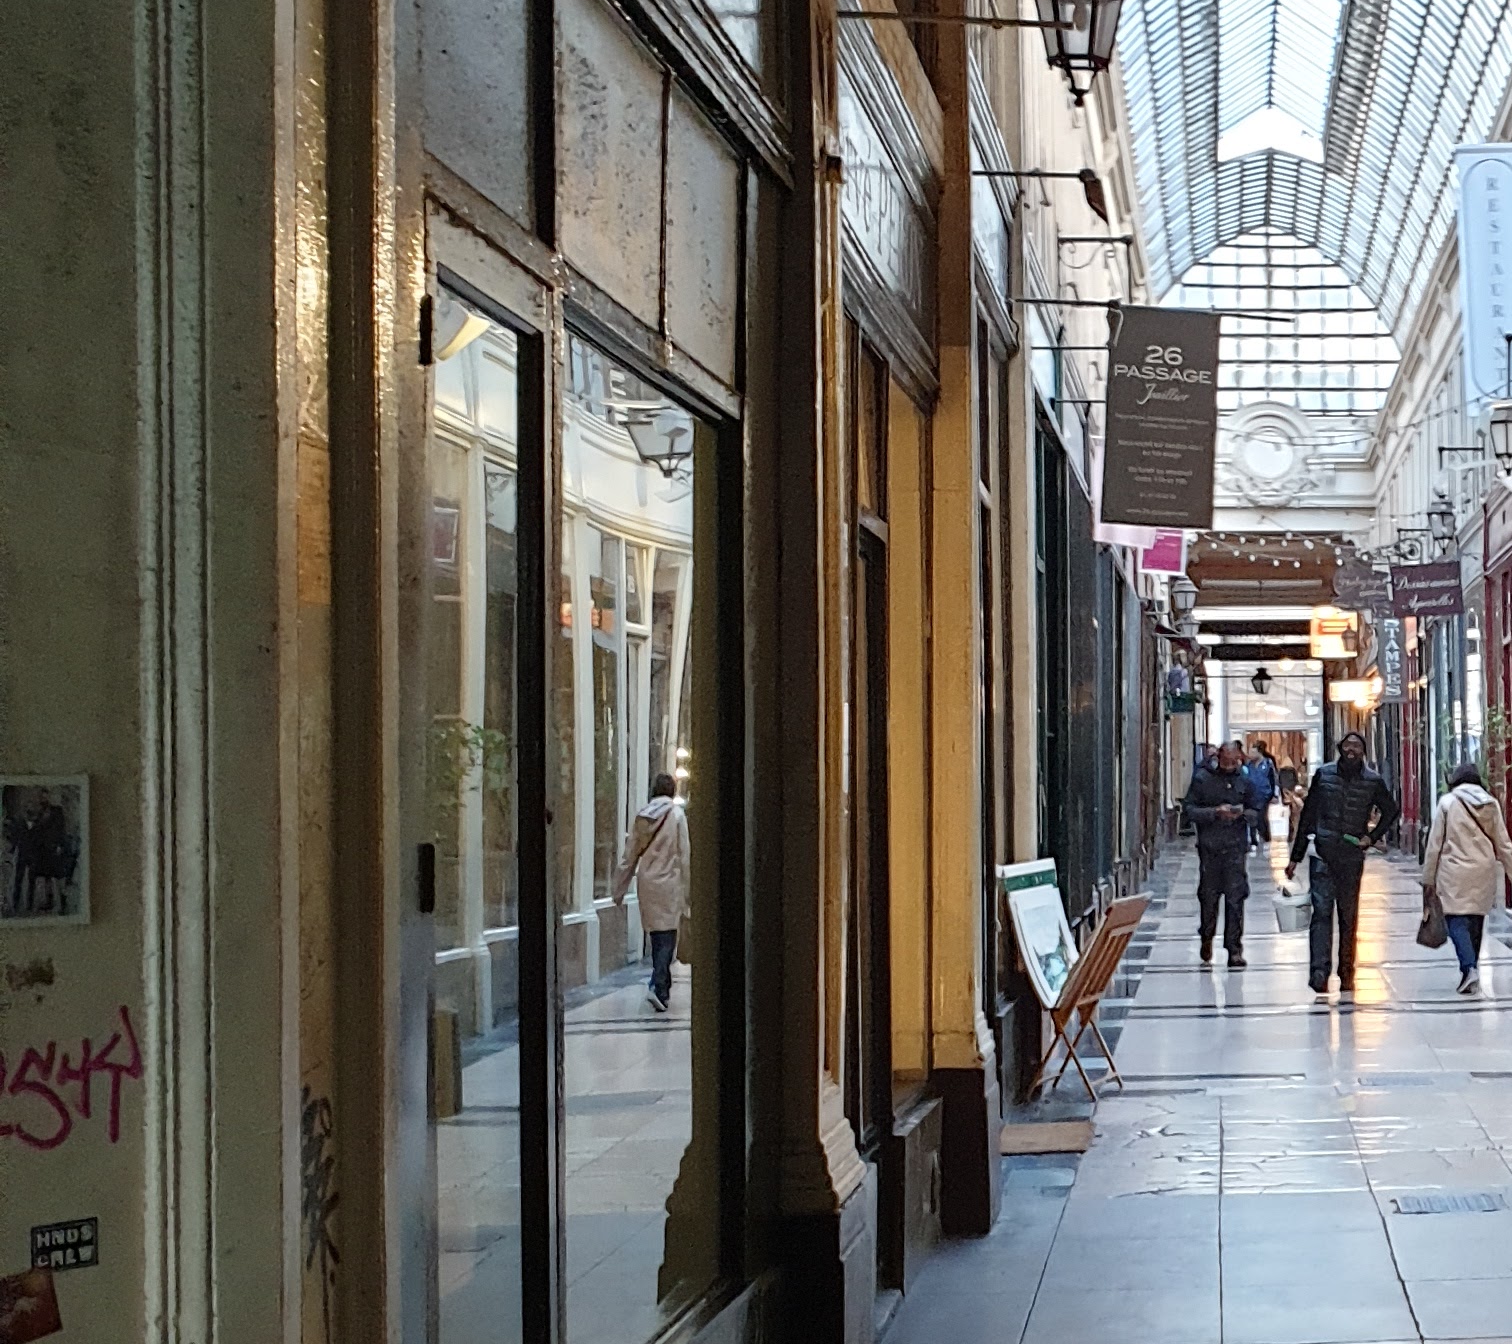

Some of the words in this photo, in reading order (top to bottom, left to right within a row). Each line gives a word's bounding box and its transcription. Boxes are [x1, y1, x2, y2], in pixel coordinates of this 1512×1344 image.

[1486, 176, 1507, 383] RESTAURANT
[1144, 345, 1184, 367] 26
[1113, 363, 1213, 385] PASSAGE
